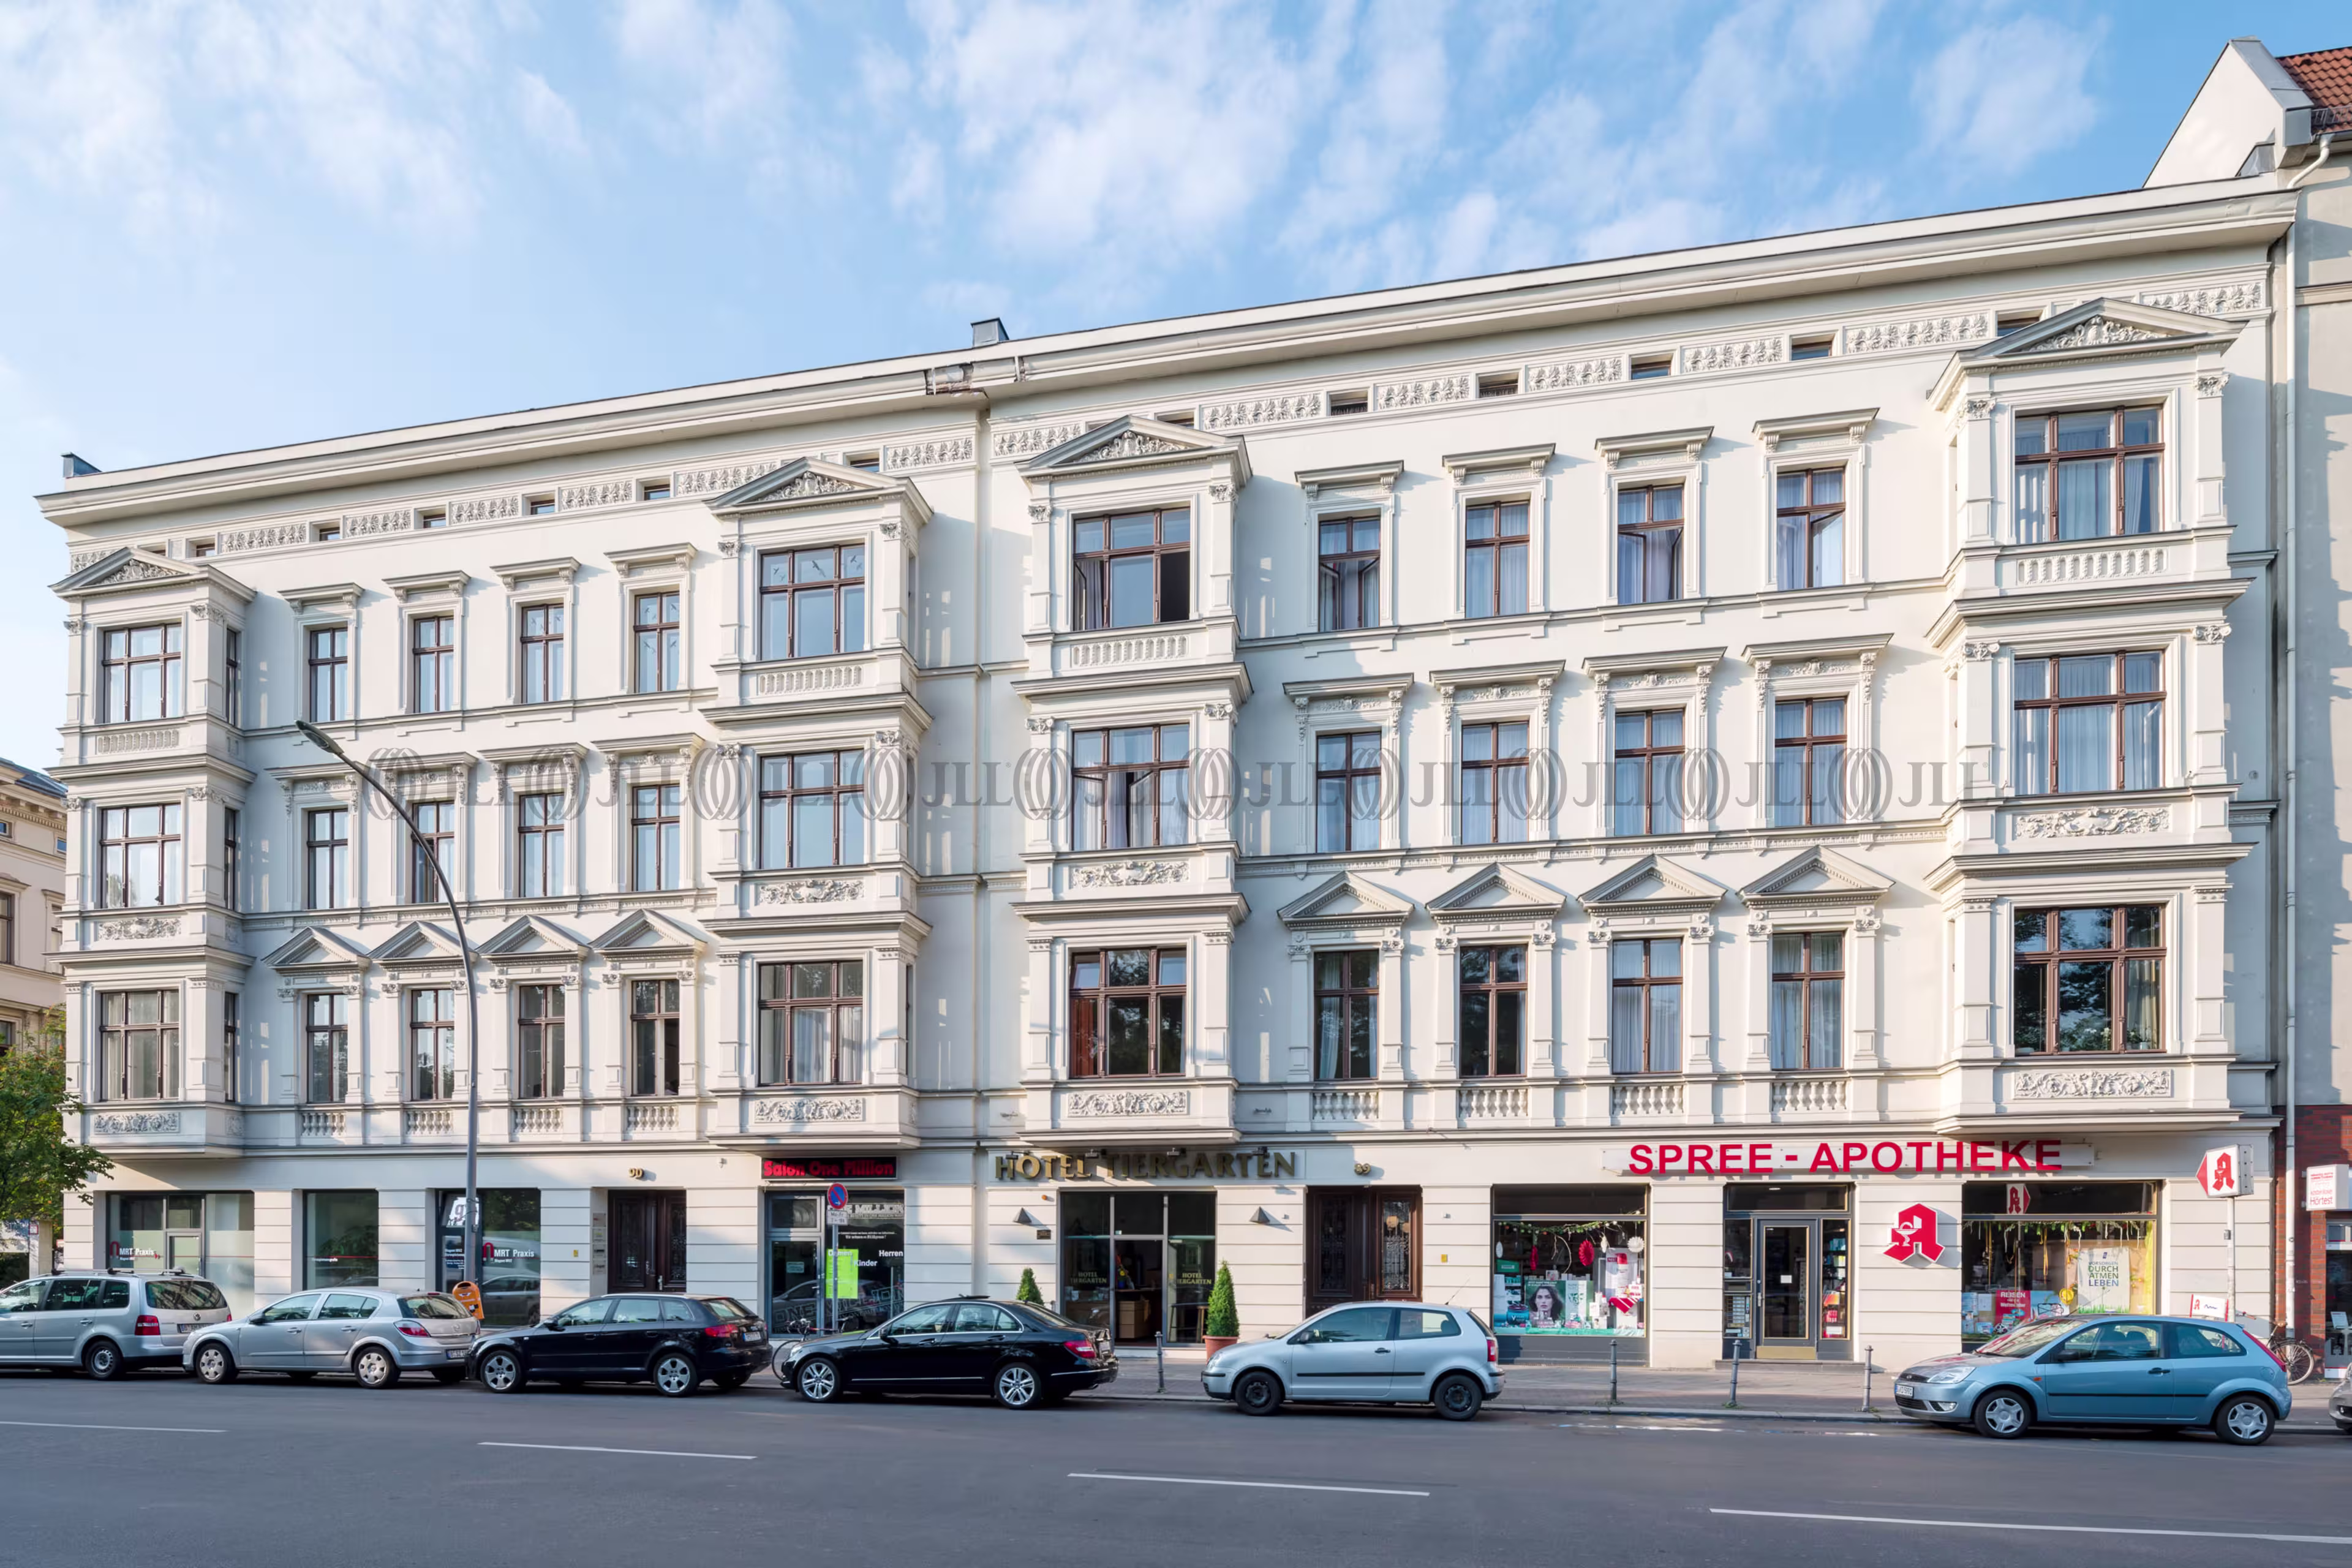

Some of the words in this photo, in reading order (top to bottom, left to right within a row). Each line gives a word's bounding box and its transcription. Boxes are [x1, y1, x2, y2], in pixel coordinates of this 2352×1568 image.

[1629, 1144, 1773, 1174] SPREE
[1809, 1140, 2062, 1173] APOTHEKE
[764, 1161, 806, 1177] Salon
[809, 1161, 840, 1175] One
[845, 1159, 894, 1175] Million
[995, 1155, 1092, 1180] HOTEL
[1106, 1152, 1296, 1178] TIERGARTEN
[1354, 1163, 1371, 1176] 89
[629, 1168, 644, 1178] 90
[2310, 1196, 2333, 1205] Hörtest
[513, 1249, 535, 1257] Praxis
